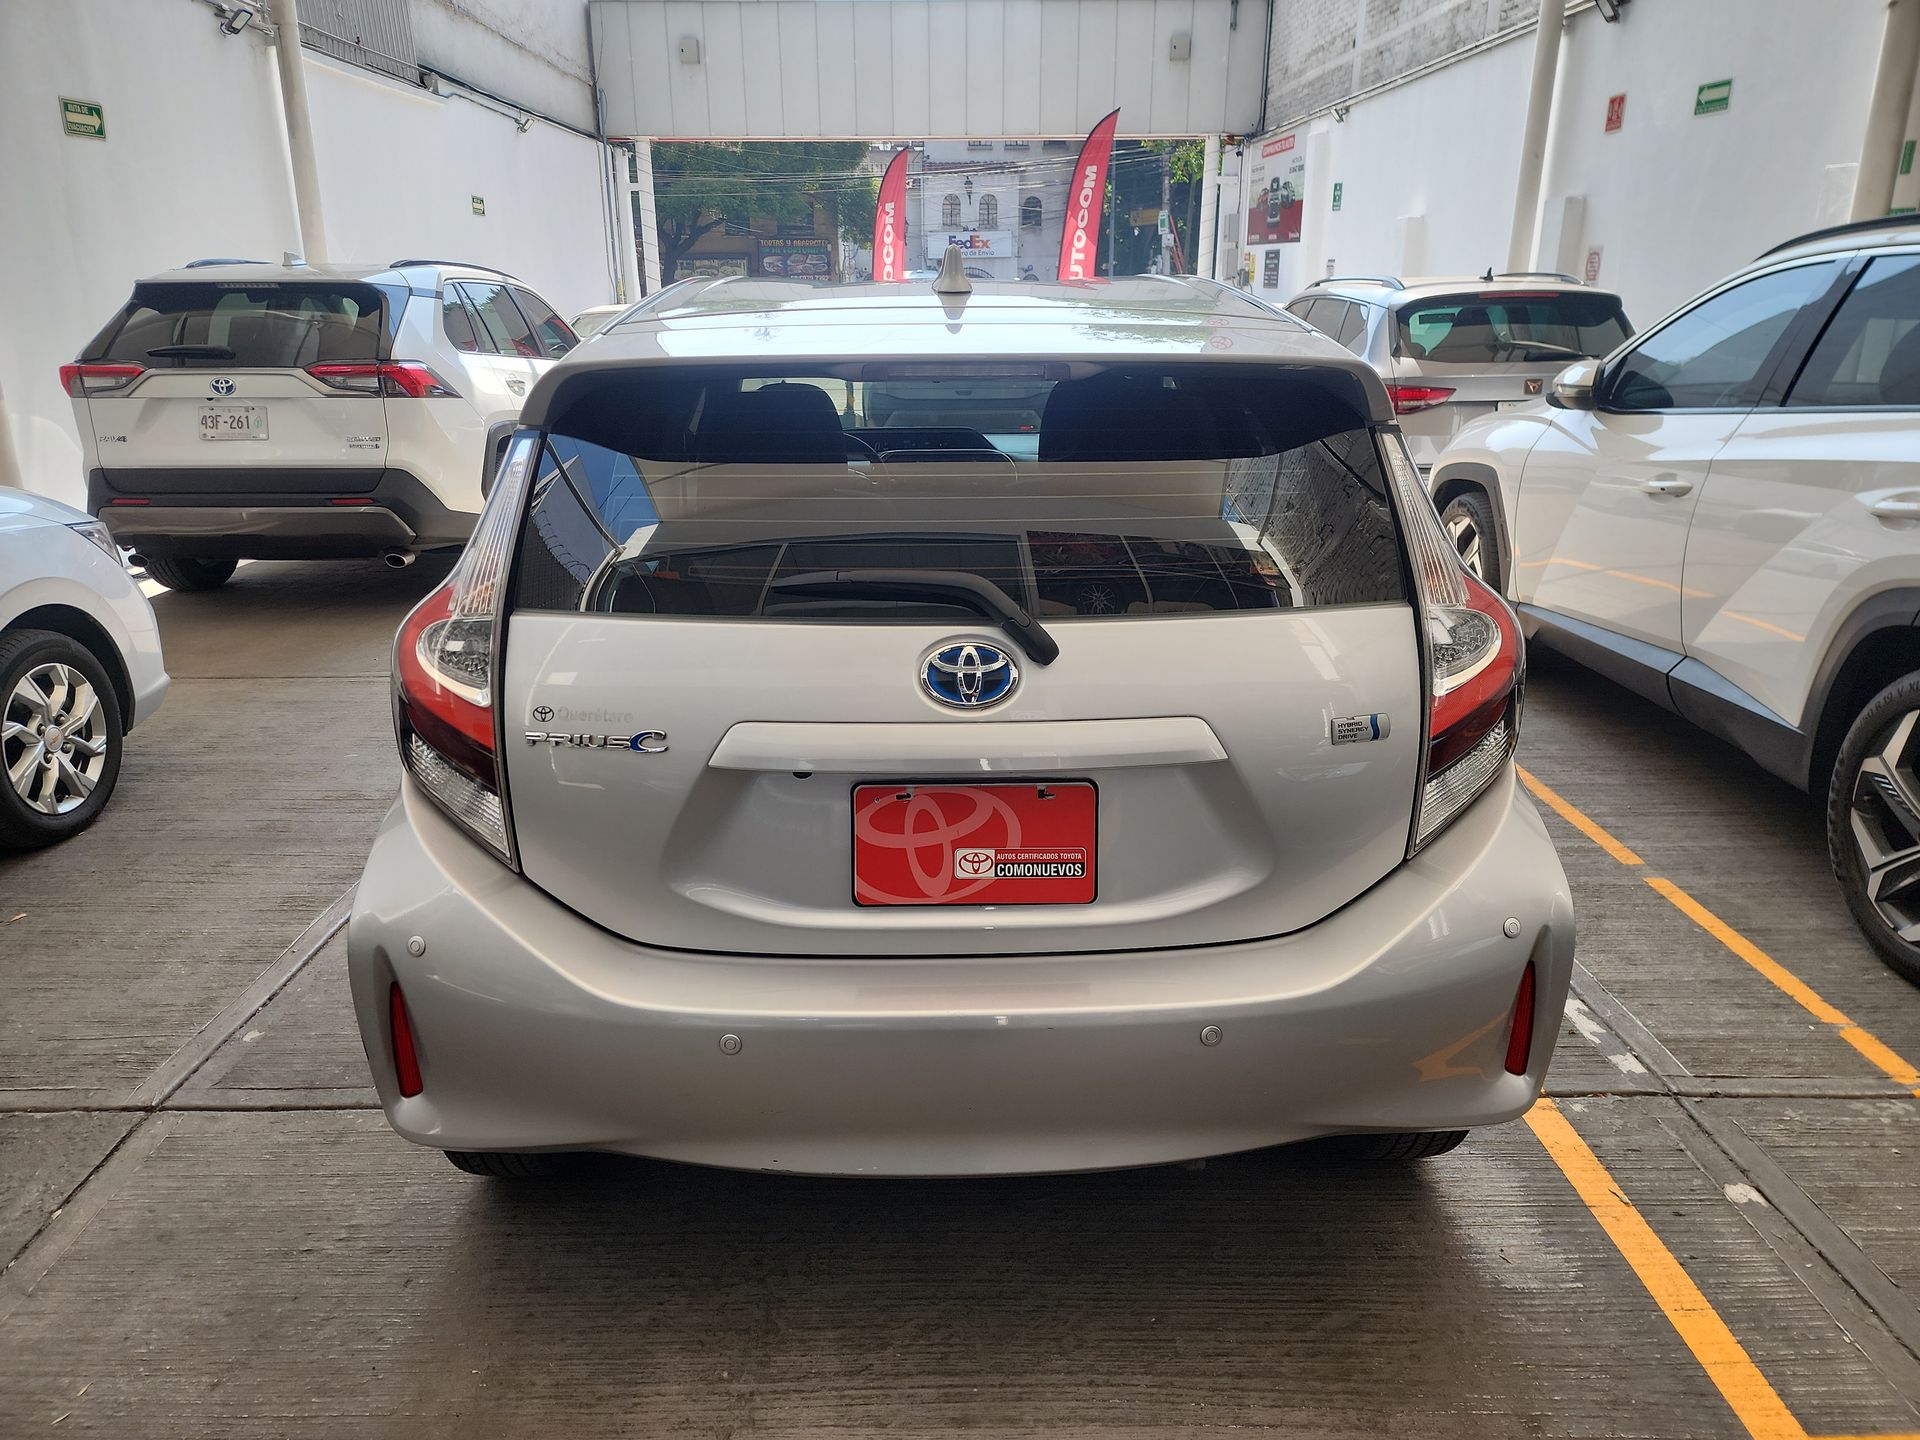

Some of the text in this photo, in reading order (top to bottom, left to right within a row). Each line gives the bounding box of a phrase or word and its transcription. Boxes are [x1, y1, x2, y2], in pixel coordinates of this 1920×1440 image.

[1069, 165, 1098, 280] UTOCOM
[760, 239, 784, 247] TORTAS
[882, 201, 895, 281] OCOM
[948, 235, 990, 249] FedEx
[200, 414, 250, 430] 43F-261
[1337, 721, 1363, 729] HYBRID
[1337, 726, 1369, 735] SYNERGY
[996, 863, 1082, 877] COMONUEVOS
